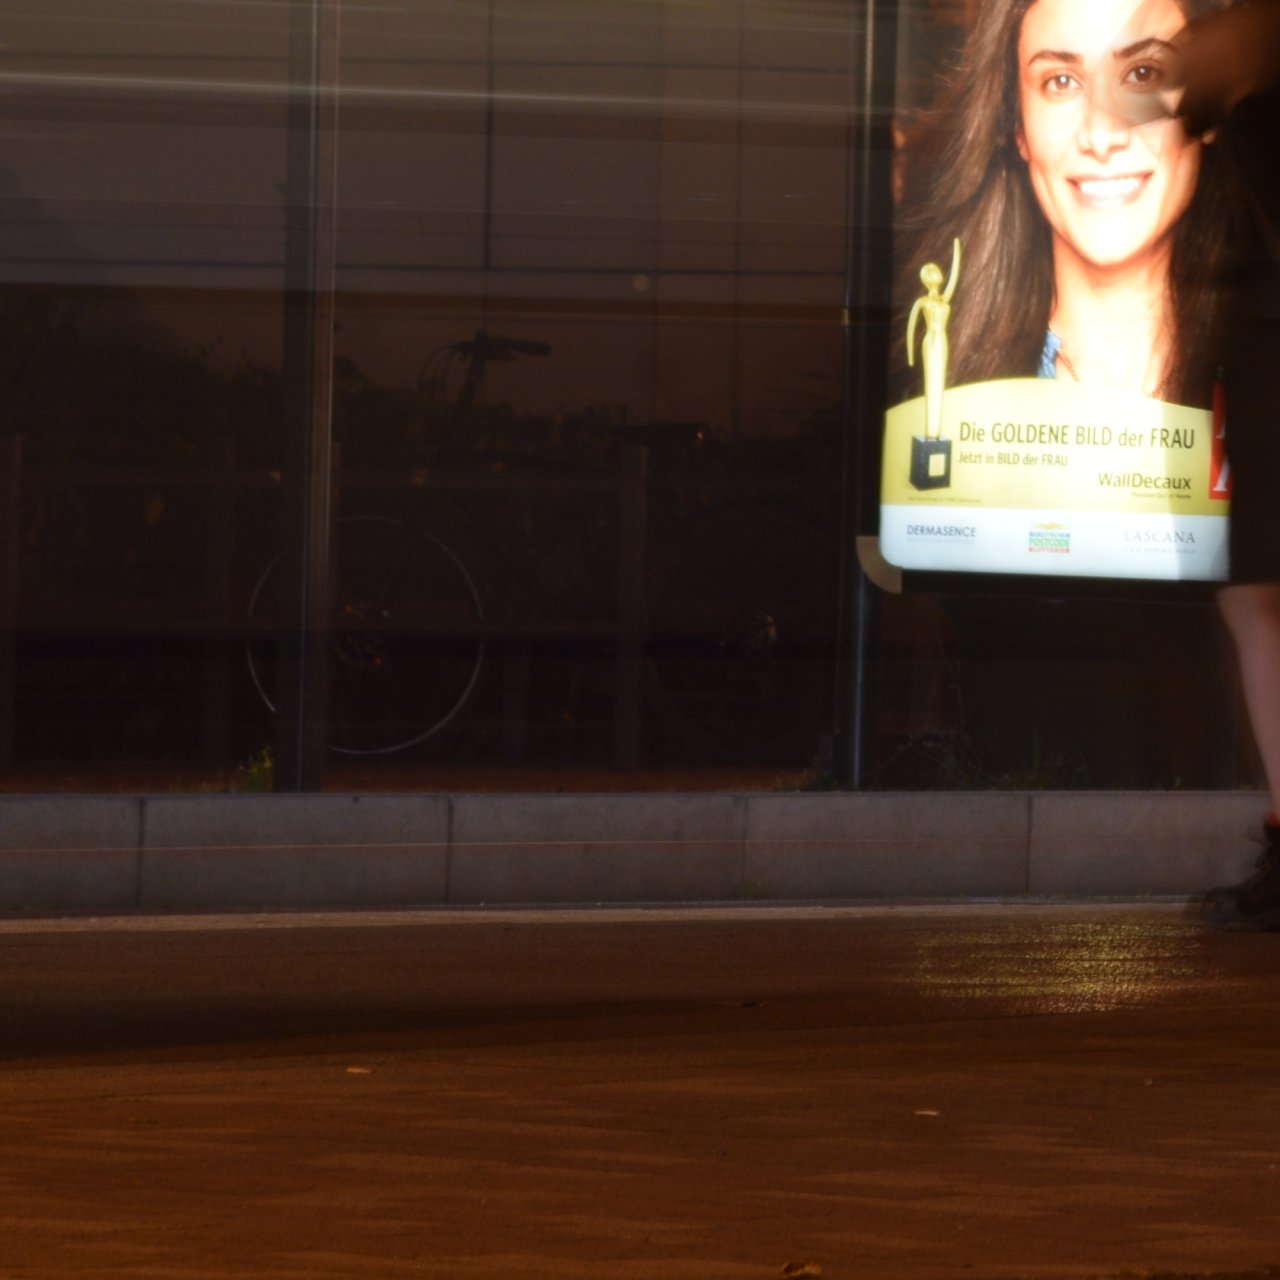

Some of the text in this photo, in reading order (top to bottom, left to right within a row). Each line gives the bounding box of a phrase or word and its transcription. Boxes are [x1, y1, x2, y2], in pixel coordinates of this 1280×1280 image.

[958, 421, 1196, 450] Die GOLDENE BILD der FRAU
[957, 451, 1069, 467] Jetzt in BILD der FRAU
[1098, 472, 1192, 491] WallDecaux
[906, 524, 977, 538] DERMASENCE
[1124, 529, 1197, 545] LASCANA
